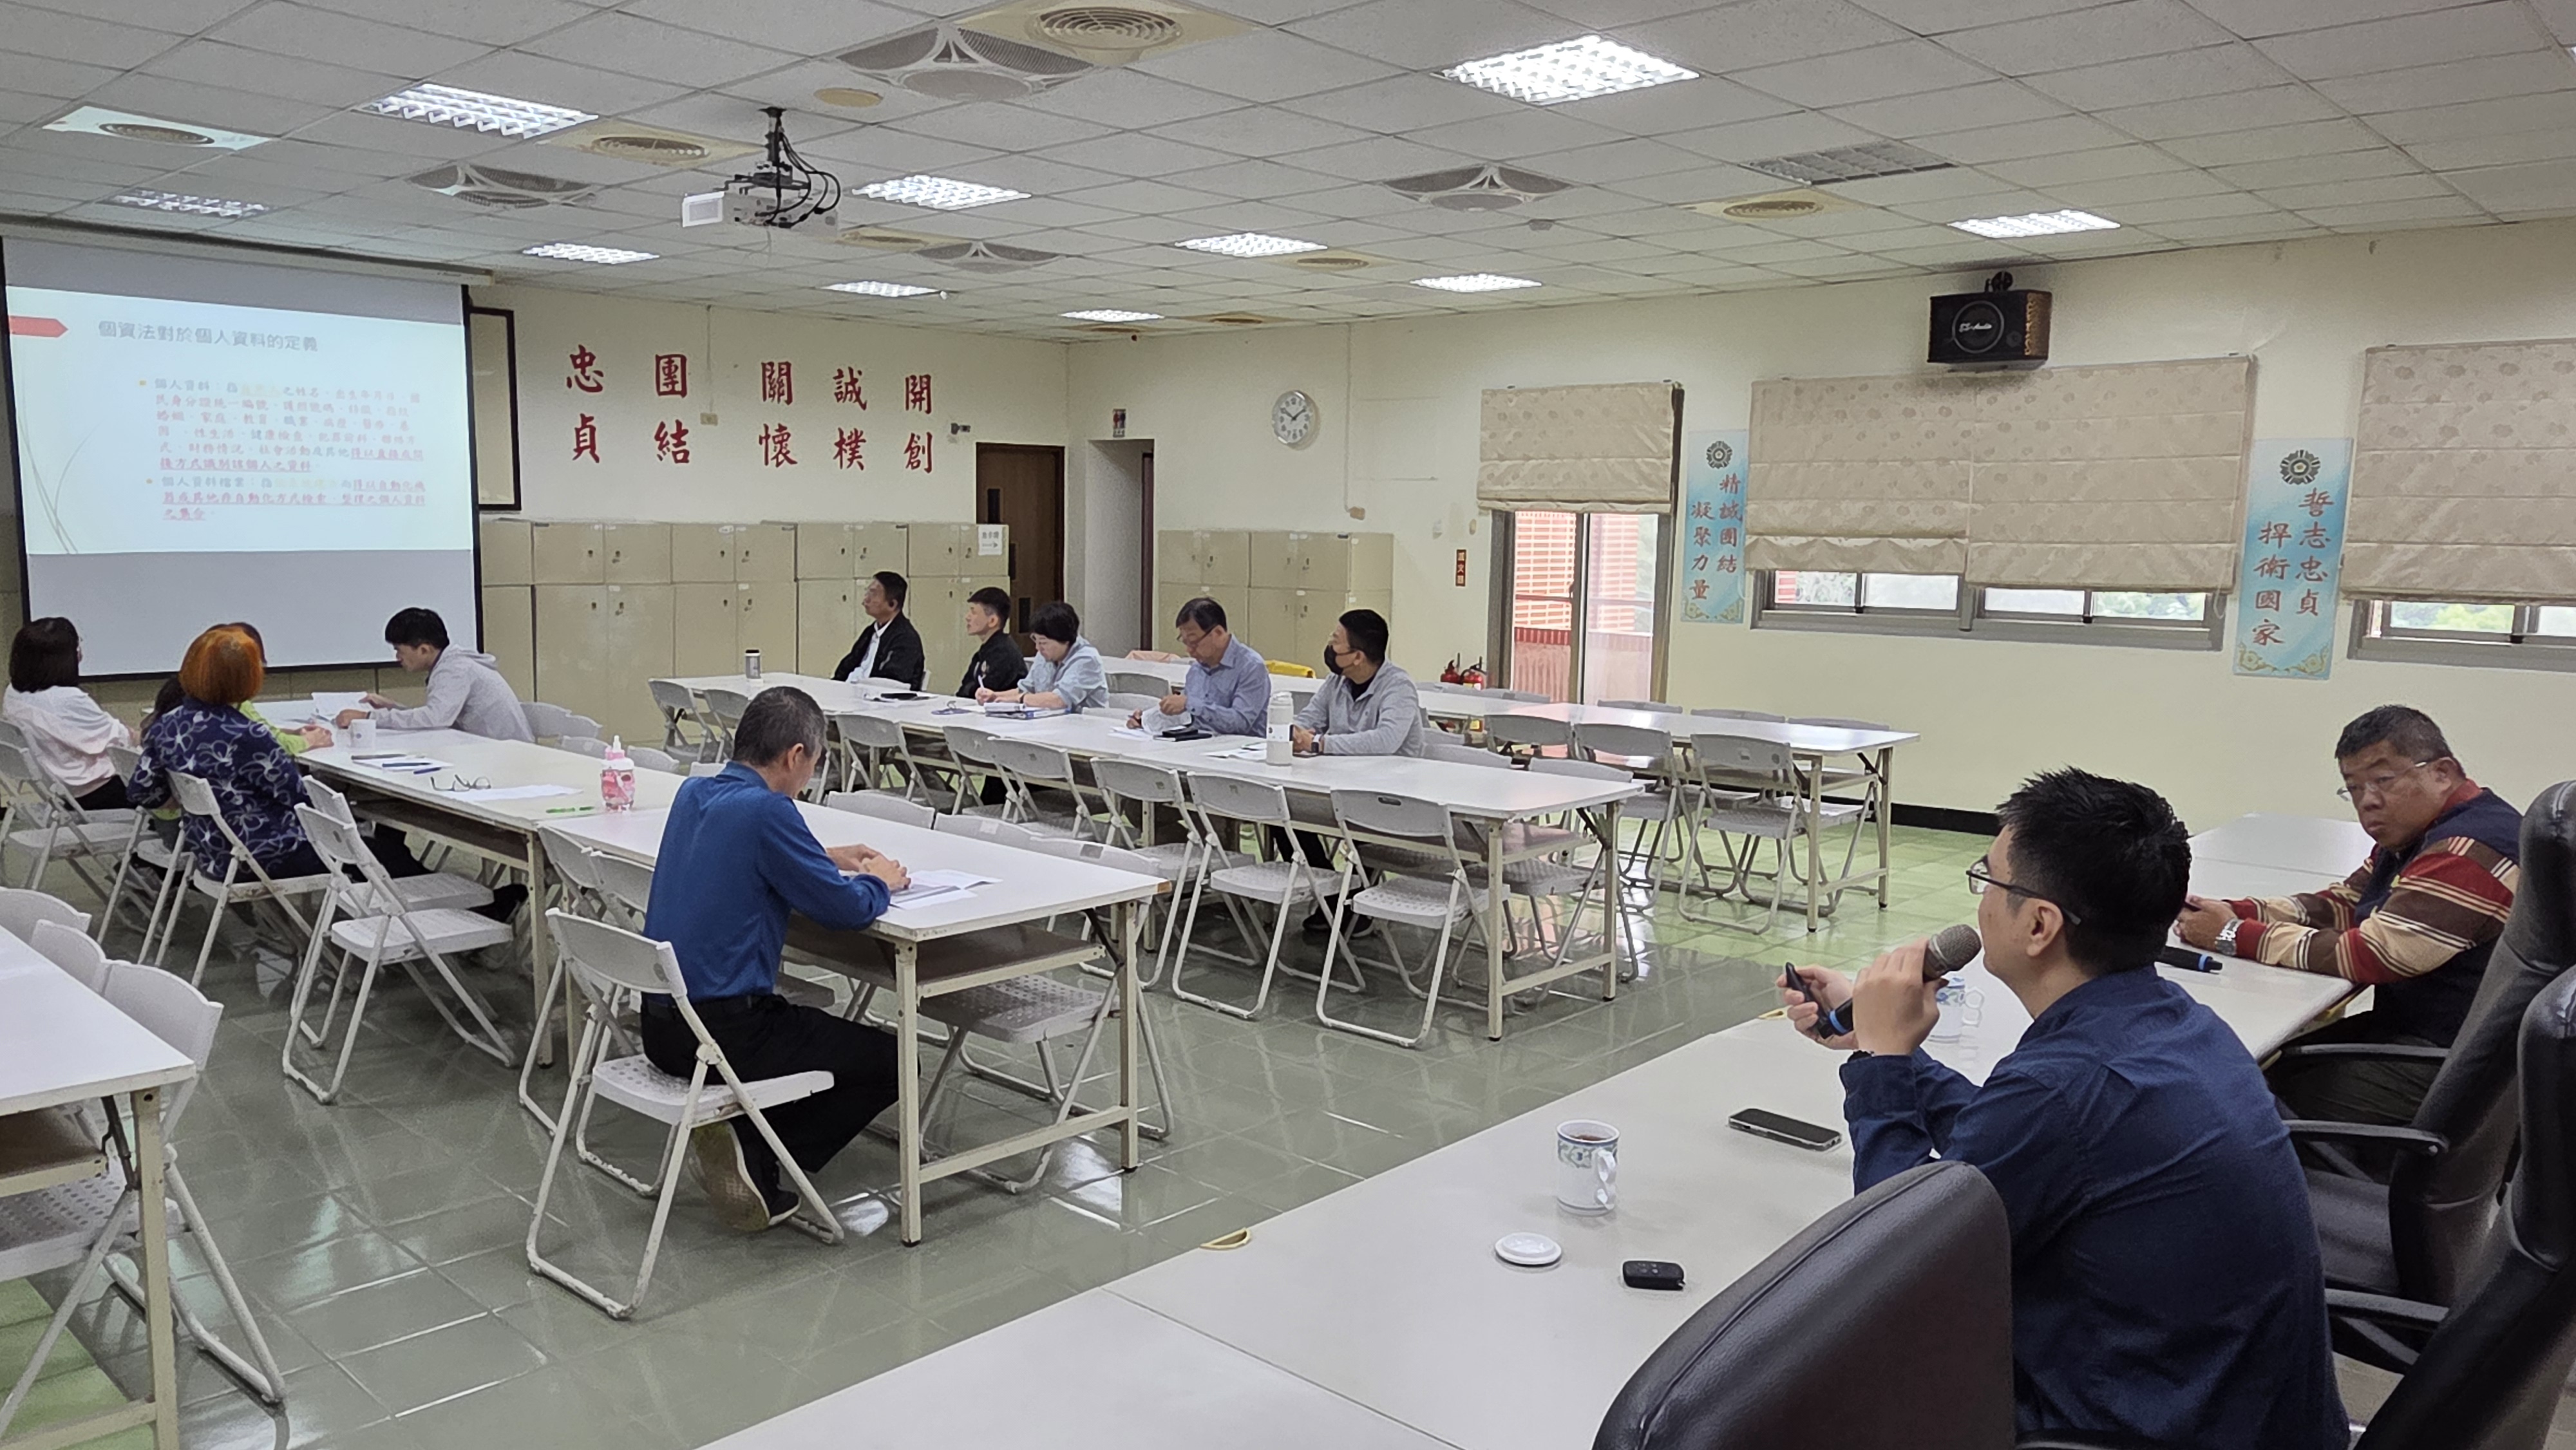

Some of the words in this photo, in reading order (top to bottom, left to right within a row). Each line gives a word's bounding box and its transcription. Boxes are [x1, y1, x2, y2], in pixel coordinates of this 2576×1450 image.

[99, 321, 318, 352] 個資法對於個人資料的定義
[566, 344, 604, 464] 忠貞
[654, 353, 690, 464] 團結
[758, 361, 798, 468] 關懷
[832, 366, 867, 471] 誠樸
[904, 373, 933, 474] 開創
[1689, 501, 1715, 599] 凝聚力量
[1716, 473, 1743, 573] 精誠團結
[2295, 487, 2334, 616] 誓志忠貞
